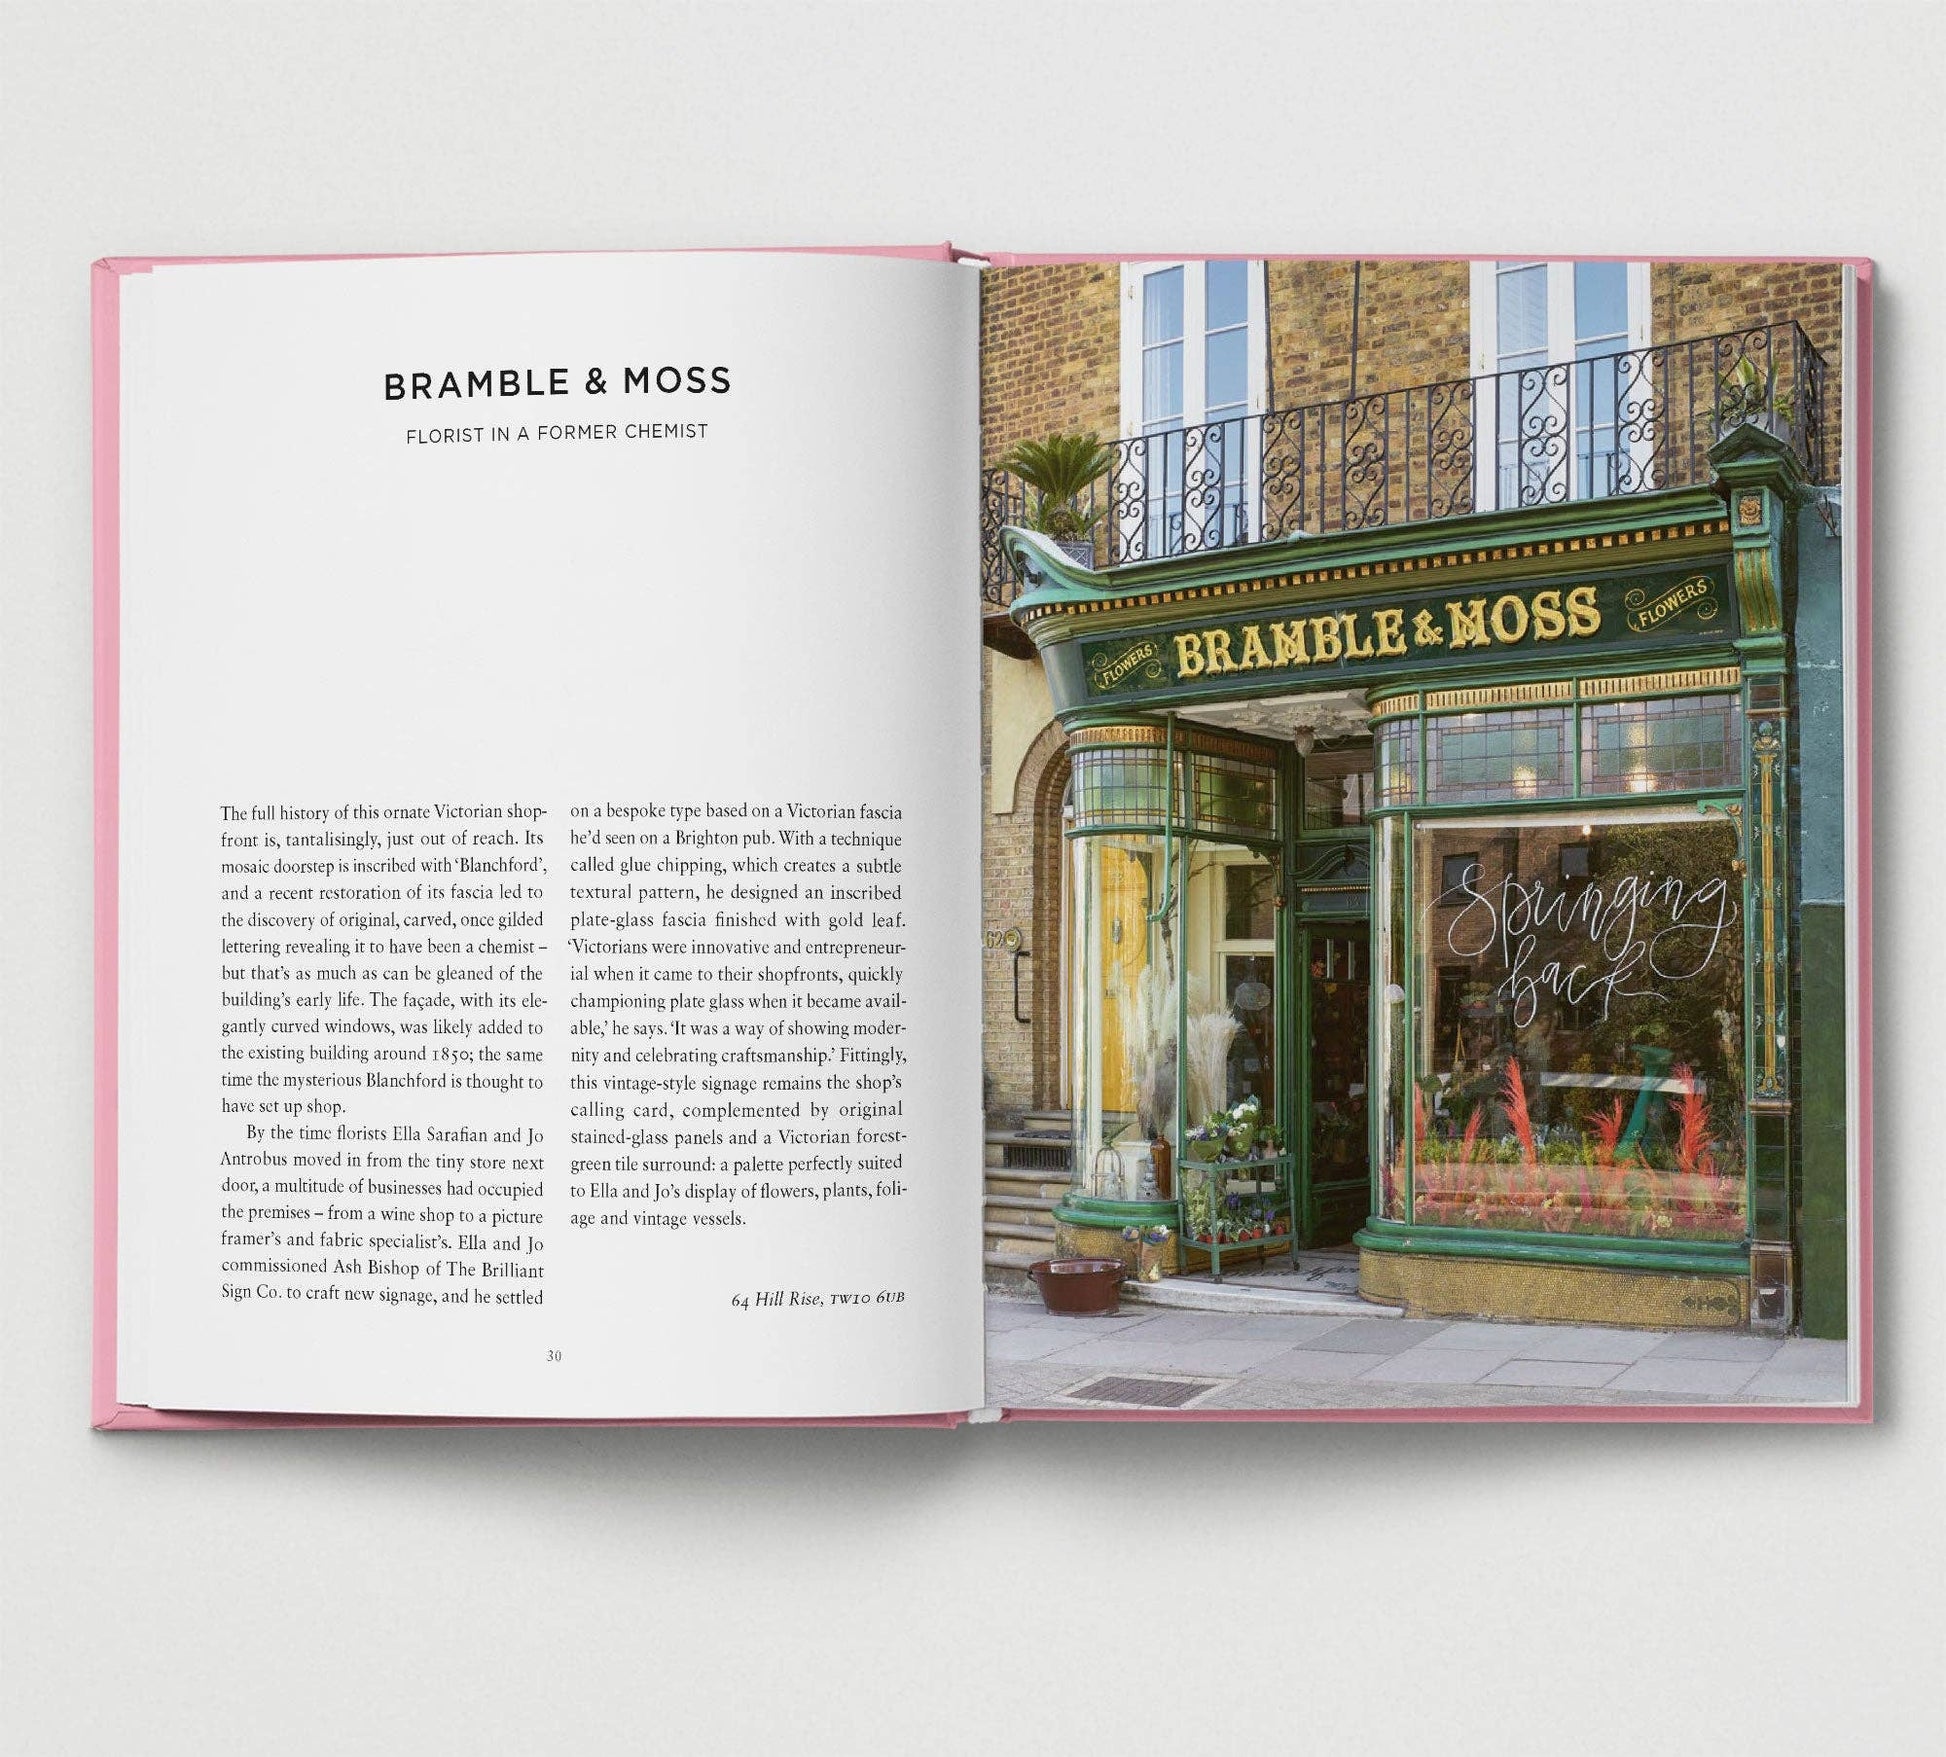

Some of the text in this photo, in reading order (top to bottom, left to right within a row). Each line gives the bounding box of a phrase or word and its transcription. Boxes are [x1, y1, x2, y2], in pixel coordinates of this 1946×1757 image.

[386, 367, 730, 400] BRAMBLE & MOSS
[407, 424, 708, 444] FLORIST IN A FORMER CHEMIST
[1638, 578, 1707, 628] FLOWERS
[1174, 586, 1602, 680] BRAMBLE & MOSS
[1102, 644, 1153, 686] FLOWERS
[220, 803, 547, 823] The full history of this ornate Victorian shop-
[222, 829, 543, 850] front is, tantalisingly, just out of reach. Its
[222, 859, 270, 873] mosaic
[274, 858, 334, 877] doorstep
[339, 859, 349, 872] is
[352, 857, 415, 872] inscribed
[421, 857, 451, 872] with
[571, 856, 903, 876] called glue chipping, which creates a subtle
[570, 884, 902, 903] textural pattern, he designed an inscribed
[222, 911, 543, 931] the discovery of original, carved, once gilded
[570, 911, 905, 931] plate-glass fascia finished with gold leaf.
[1421, 863, 1738, 979] Springing
[652, 943, 686, 954] were
[692, 939, 769, 954] innovative
[774, 939, 801, 954] and
[806, 942, 906, 958] entrepreneur-
[1497, 934, 1670, 1028] back
[296, 992, 331, 1010] early
[338, 991, 364, 1006] life.
[369, 992, 397, 1006] The
[403, 992, 455, 1011] façade,
[460, 992, 493, 1007] with
[499, 993, 516, 1007] its
[522, 993, 547, 1007] ele-
[222, 1018, 543, 1038] gantly curved windows, was likely added to
[222, 1045, 543, 1065] the existing building around 1850; the same
[572, 1047, 599, 1066] nity
[604, 1047, 630, 1062] and
[636, 1047, 717, 1066] celebrating
[840, 1046, 906, 1065] Fittingly,
[571, 1074, 597, 1089] this
[603, 1075, 696, 1095] vintage-style
[702, 1075, 757, 1095] signage
[763, 1075, 821, 1090] remains
[827, 1074, 850, 1089] the
[570, 1100, 902, 1122] calling card, complemented by original
[247, 1124, 543, 1146] By the time florists Ella Sarafian and Jo
[571, 1128, 906, 1148] stained-glass panels and a Victorian forest-
[219, 1177, 543, 1201] door, a multitude of businesses had occupied
[287, 1231, 314, 1246] and
[320, 1231, 363, 1247] fabric
[458, 1234, 486, 1253] Ella
[493, 1236, 520, 1250] and
[526, 1236, 543, 1254] Jo
[222, 1257, 544, 1279] commissioned Ash Bishop of The Brilliant
[732, 1294, 749, 1311] 64
[756, 1291, 784, 1306] Hill
[789, 1291, 823, 1307] Rise,
[876, 1290, 904, 1304] 6UB
[548, 1350, 561, 1361] 30
